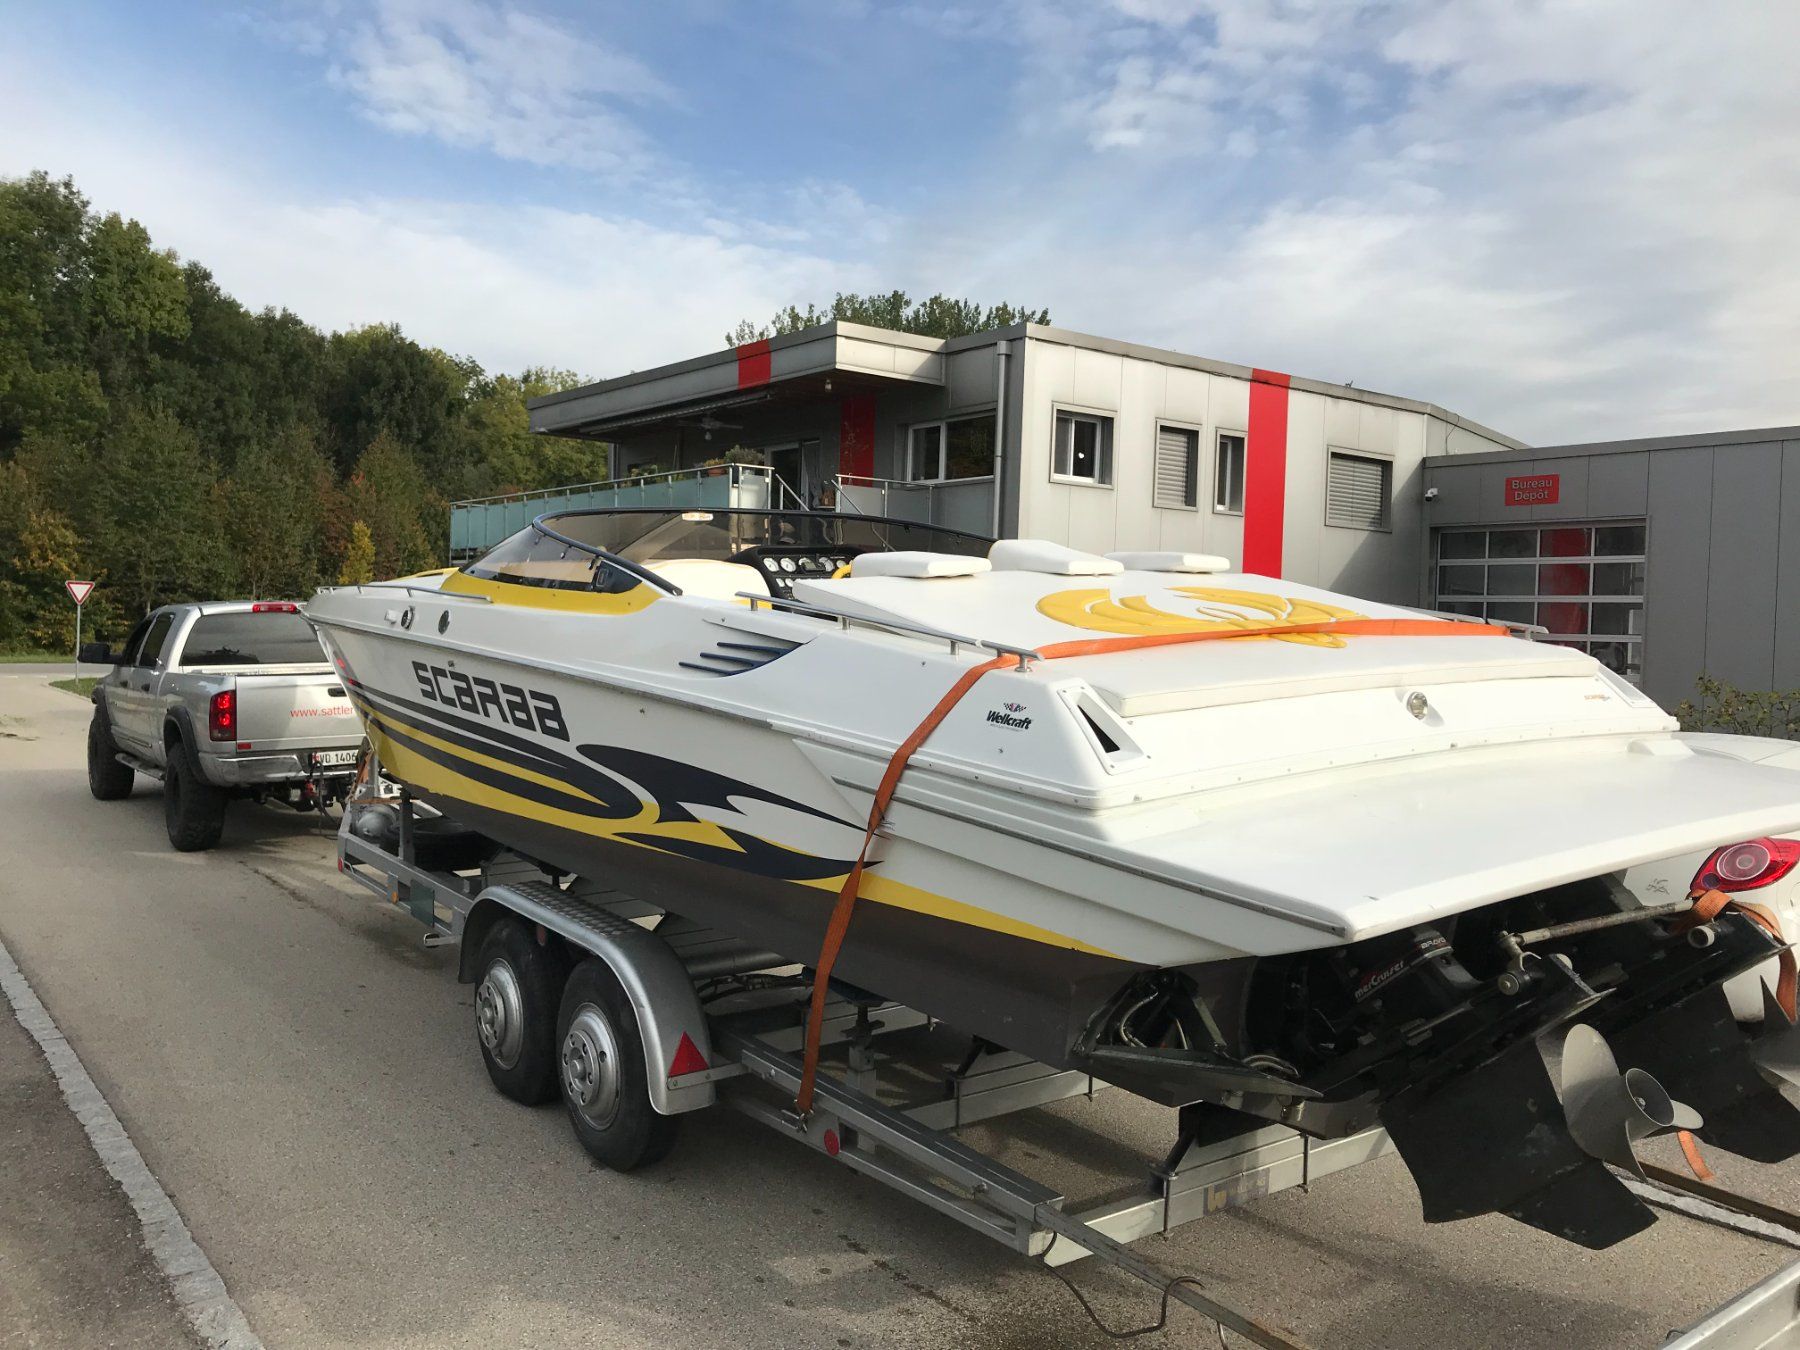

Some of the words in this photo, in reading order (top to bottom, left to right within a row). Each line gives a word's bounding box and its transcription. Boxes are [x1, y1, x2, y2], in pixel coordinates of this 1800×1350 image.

[1512, 479, 1552, 489] Bureau
[1514, 489, 1549, 501] Dépôt
[986, 710, 1031, 730] Wellcraft
